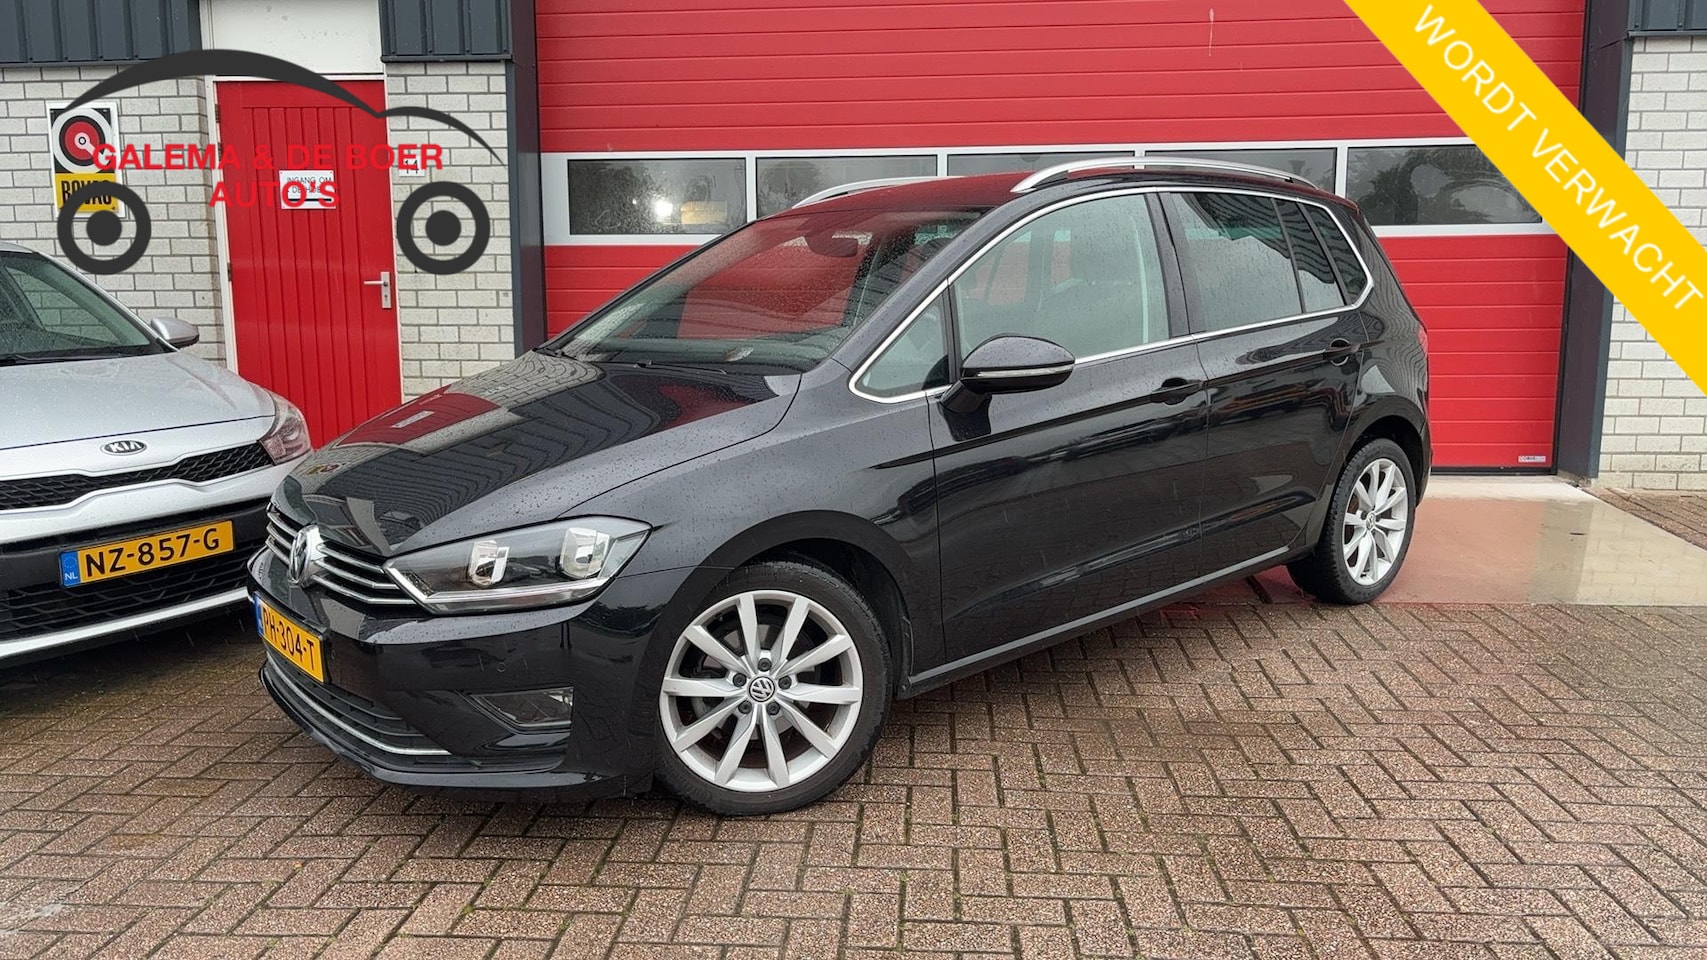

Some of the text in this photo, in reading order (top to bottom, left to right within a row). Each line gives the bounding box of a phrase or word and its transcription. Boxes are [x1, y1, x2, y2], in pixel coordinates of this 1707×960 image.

[109, 441, 141, 453] KIA
[85, 528, 220, 578] NZ-857-G
[64, 572, 79, 581] NL
[263, 607, 315, 671] PH-304-T
